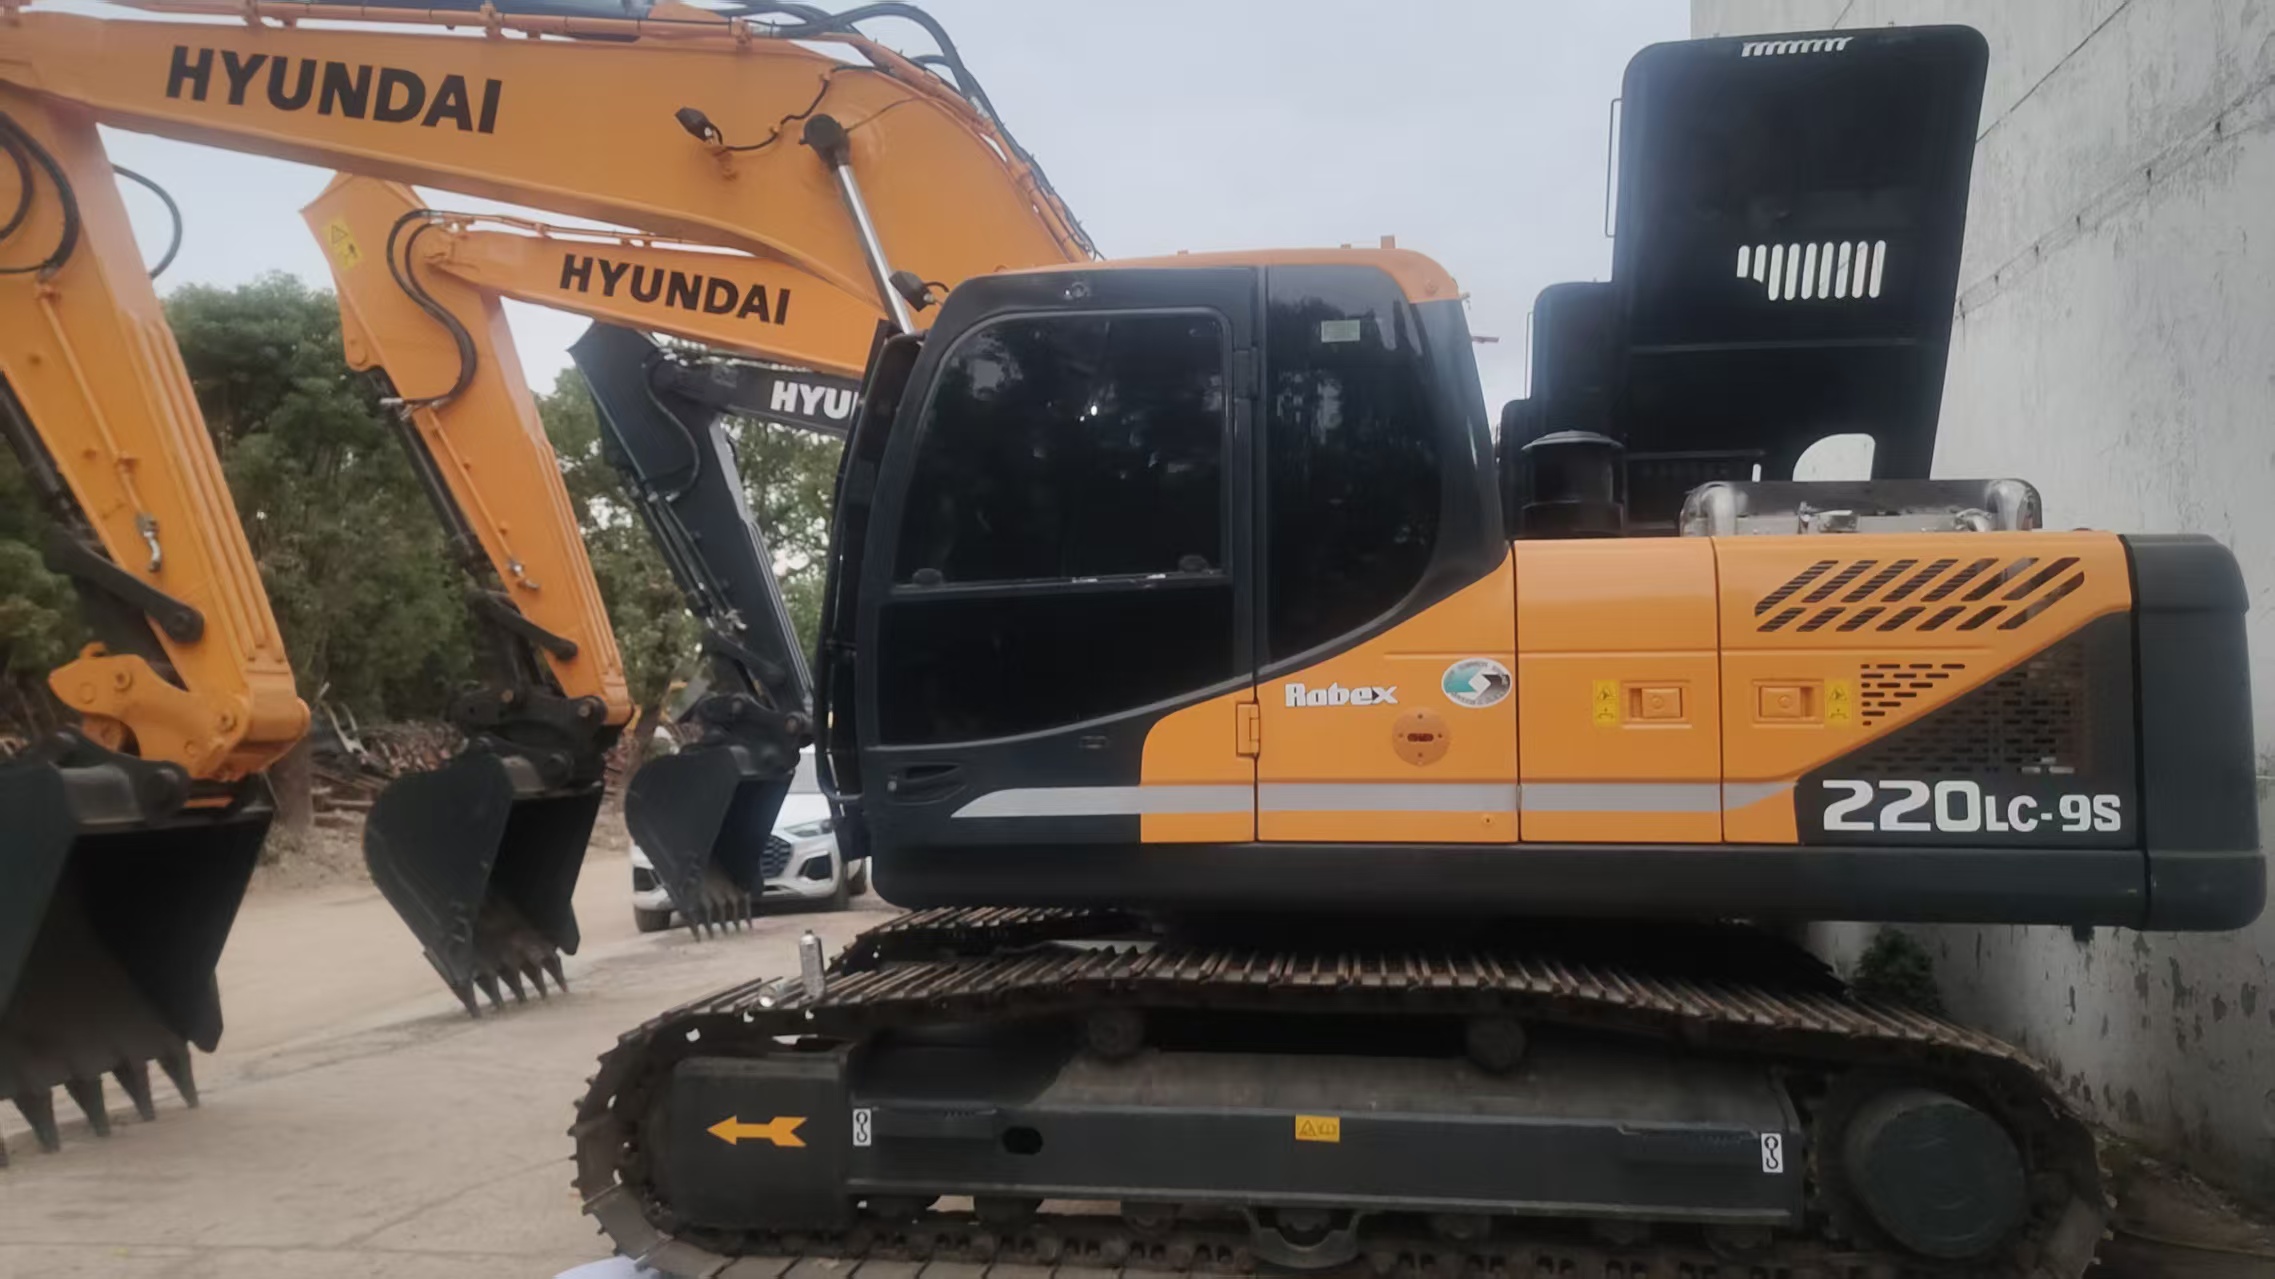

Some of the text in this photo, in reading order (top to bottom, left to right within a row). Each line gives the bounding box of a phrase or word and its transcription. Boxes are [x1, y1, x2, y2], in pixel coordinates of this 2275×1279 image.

[165, 45, 502, 134] HYUNDAI
[559, 253, 790, 325] HYUNDAI
[1285, 682, 1398, 707] Robex
